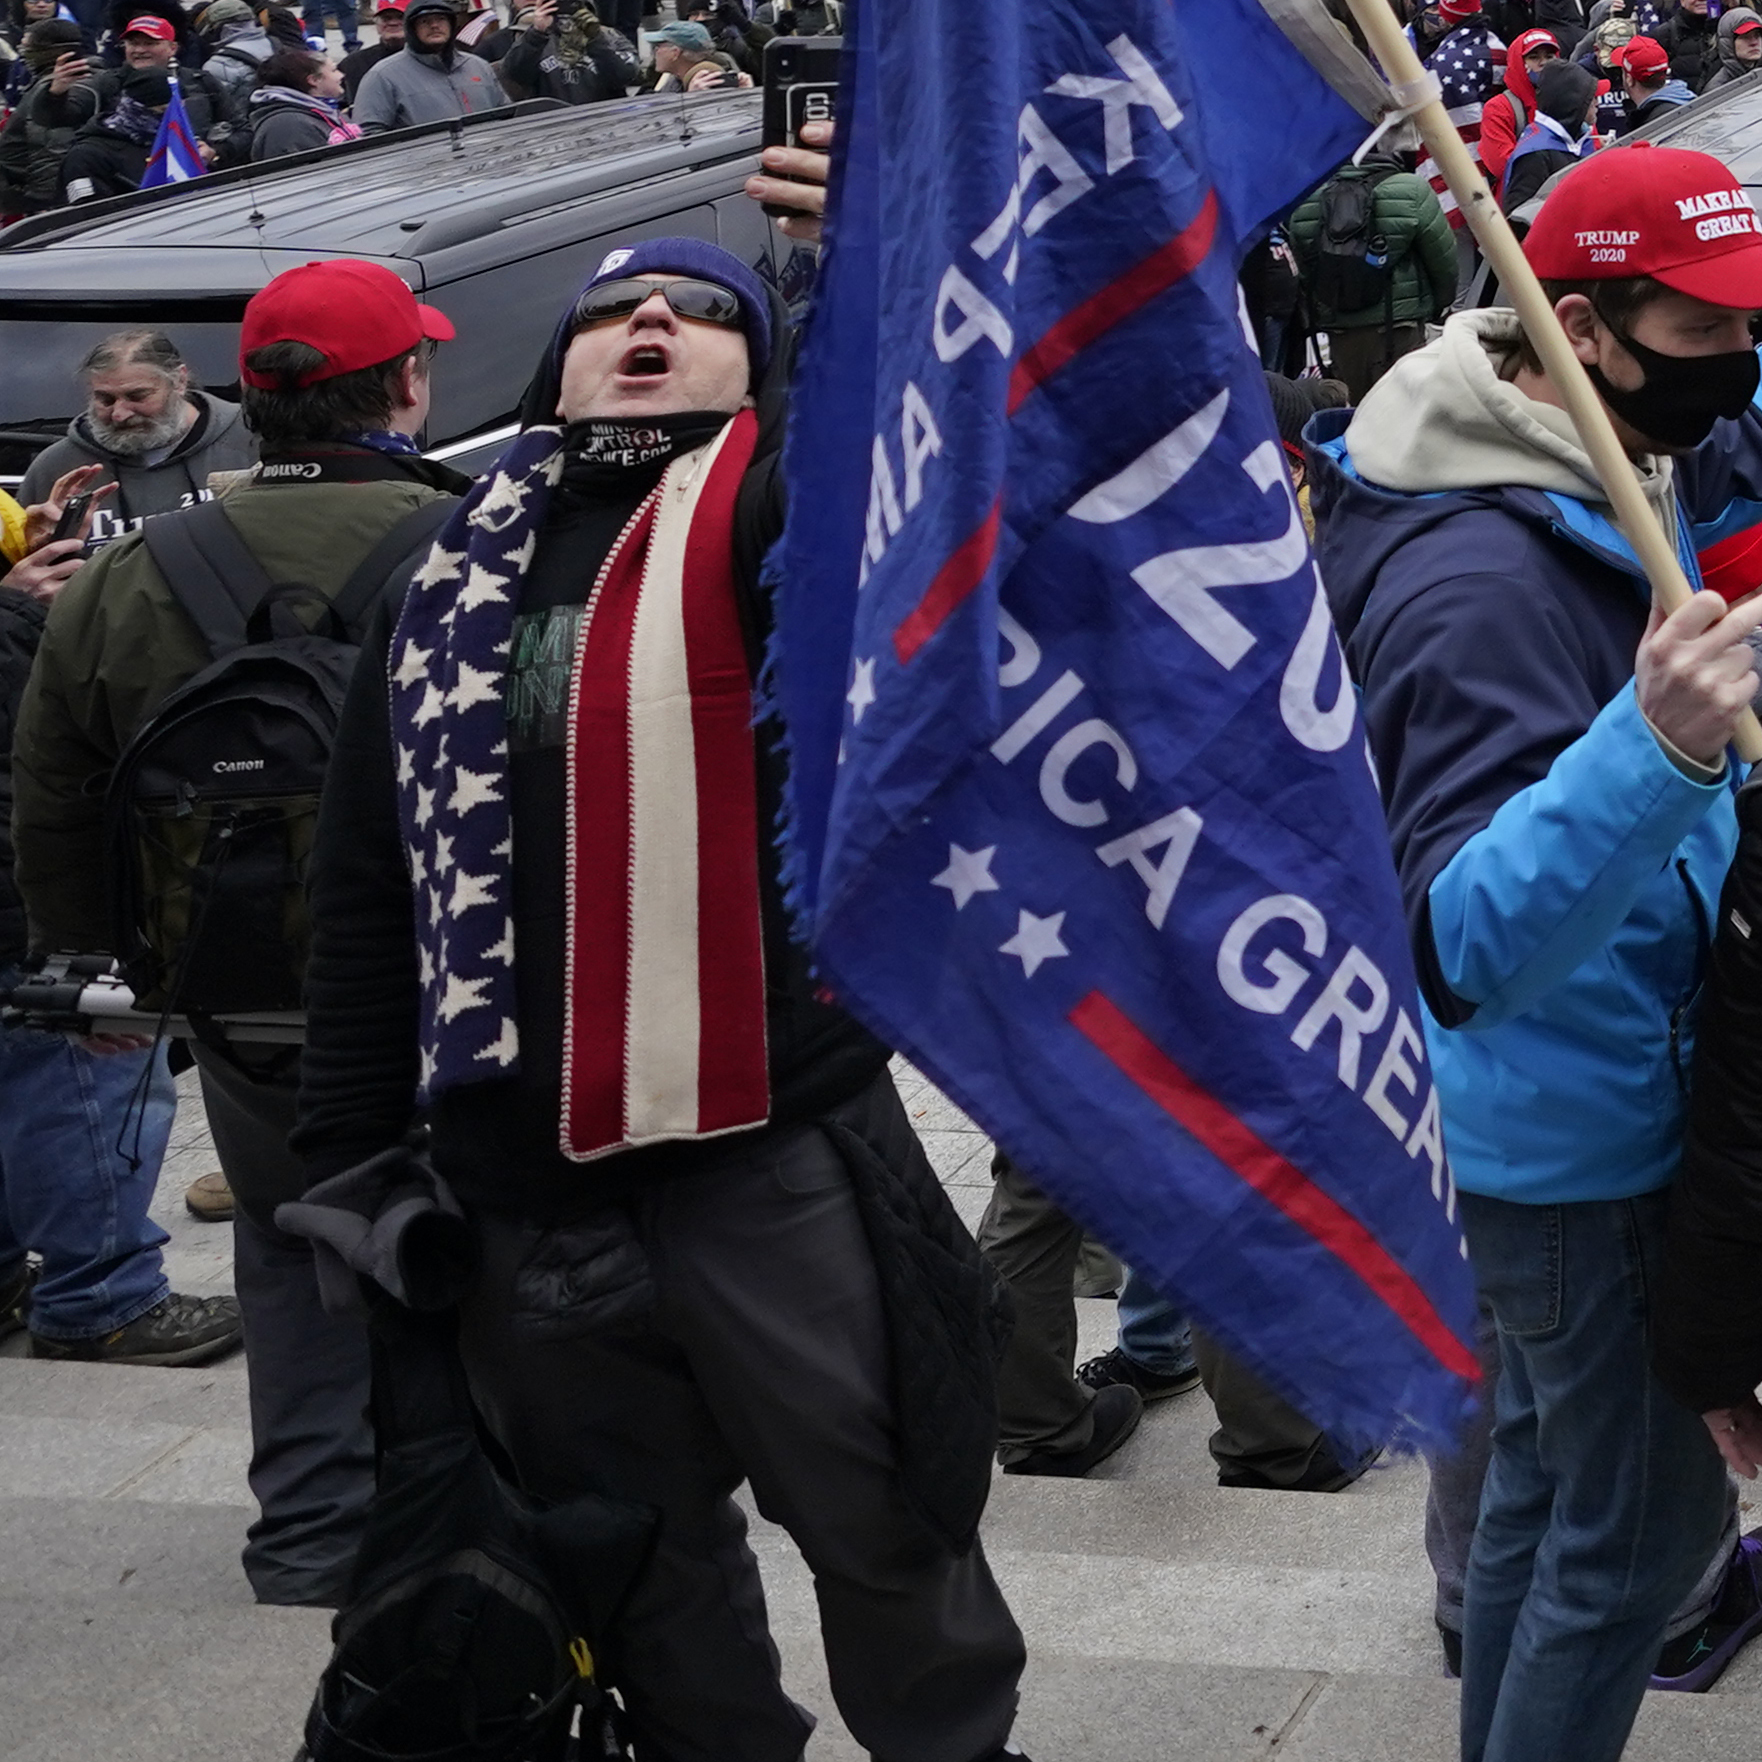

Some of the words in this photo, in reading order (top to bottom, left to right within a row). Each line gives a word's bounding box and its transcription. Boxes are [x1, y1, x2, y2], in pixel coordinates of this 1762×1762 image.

[1674, 190, 1733, 221] MAKE
[1694, 214, 1752, 241] GREAT
[1574, 230, 1640, 247] TRUMP
[1589, 248, 1626, 263] 2020
[262, 462, 323, 478] Canon
[212, 758, 265, 774] Canon
[1215, 892, 1470, 1262] GREA
